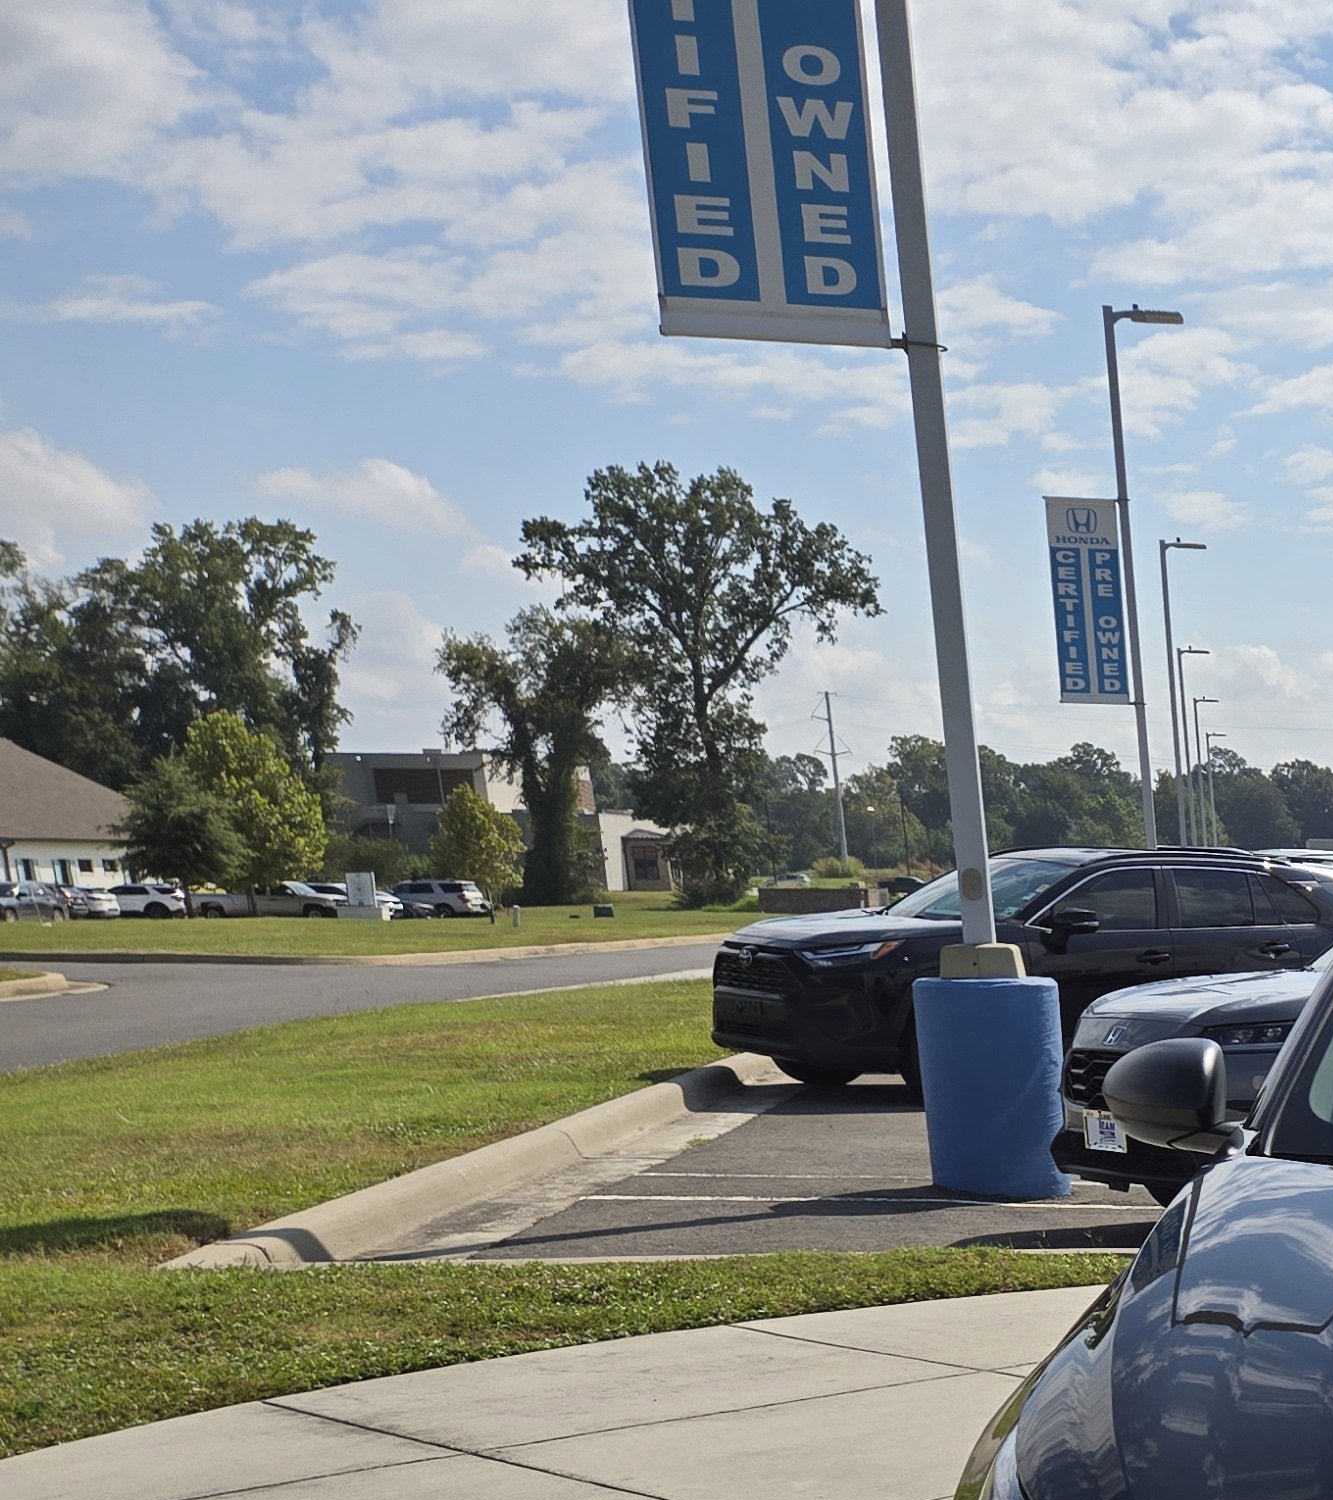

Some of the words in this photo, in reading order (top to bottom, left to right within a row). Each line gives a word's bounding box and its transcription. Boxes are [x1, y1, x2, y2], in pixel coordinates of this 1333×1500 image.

[776, 45, 857, 295] OWNED
[1055, 535, 1111, 546] HONDA
[1095, 552, 1114, 597] PRE
[1055, 550, 1086, 690] CERTIFIED
[1097, 615, 1121, 691] OWNED
